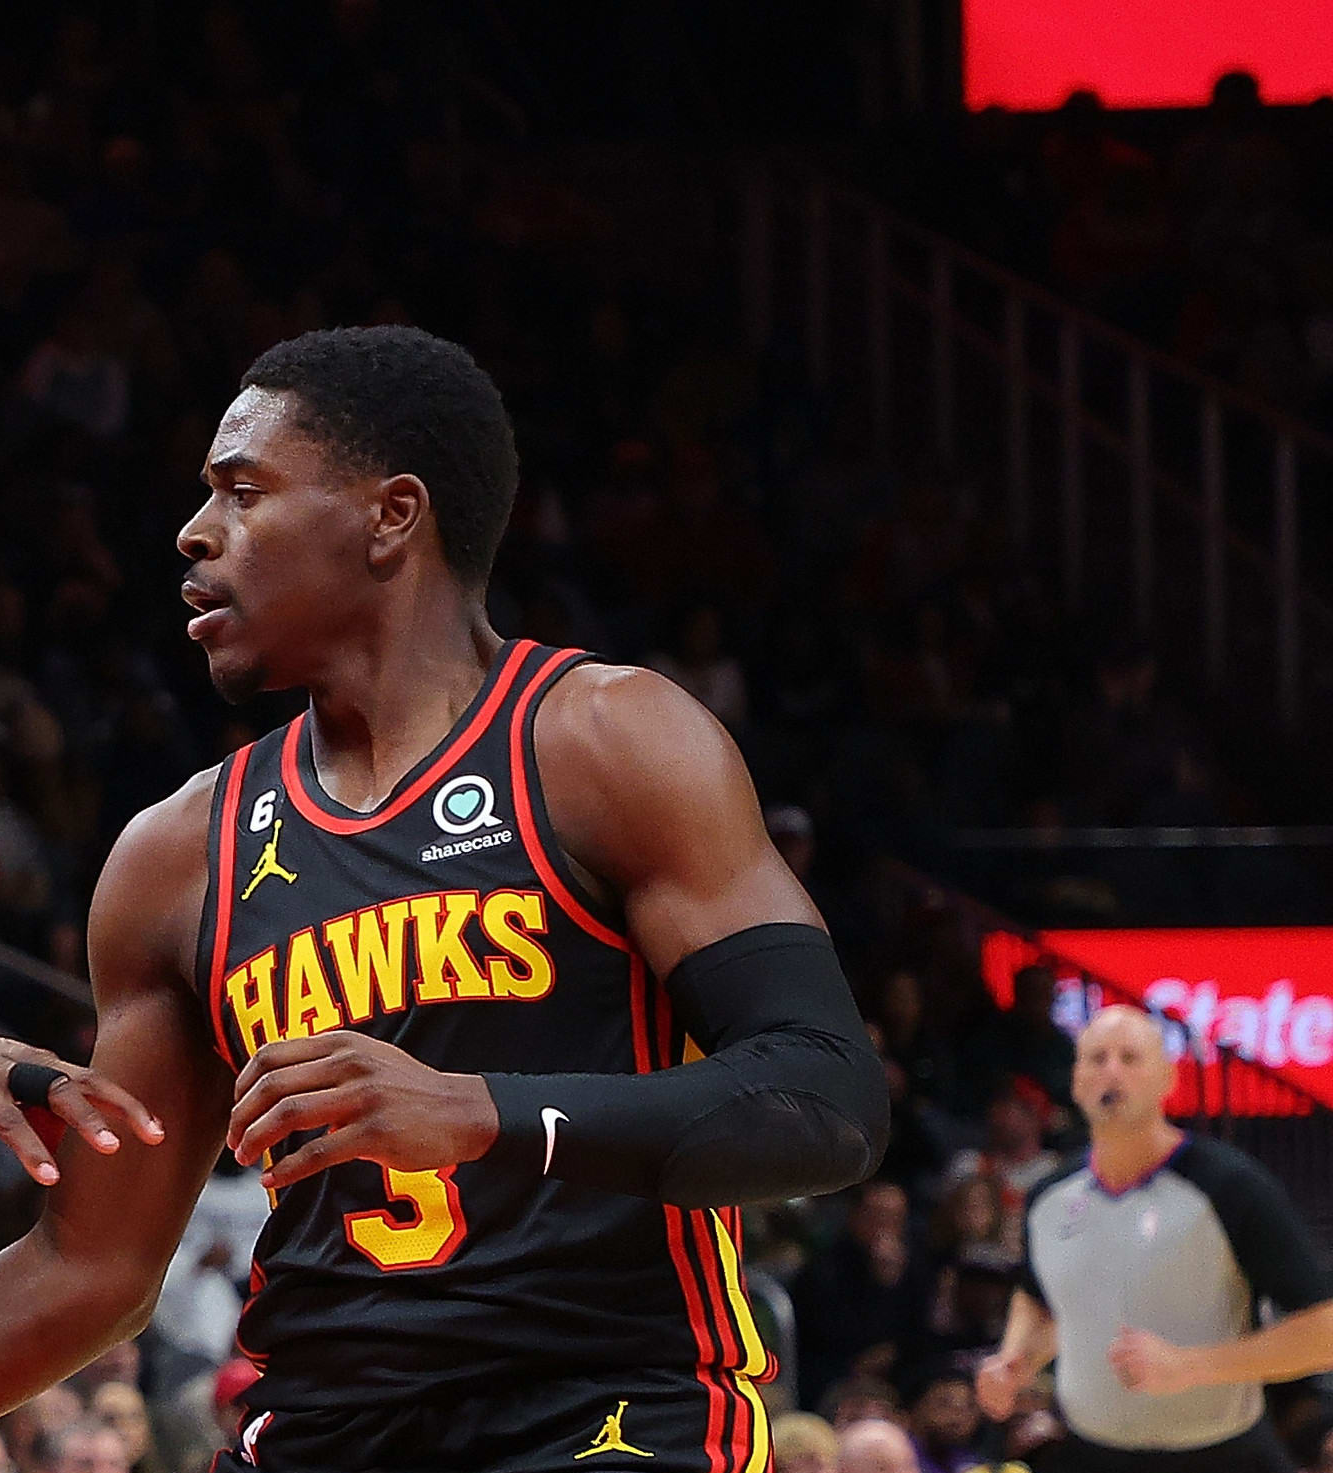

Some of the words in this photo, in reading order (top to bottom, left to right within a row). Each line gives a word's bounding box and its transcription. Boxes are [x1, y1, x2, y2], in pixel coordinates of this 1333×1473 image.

[249, 789, 278, 834] 6
[420, 830, 513, 862] sharecare
[225, 889, 554, 1058] HAWKS
